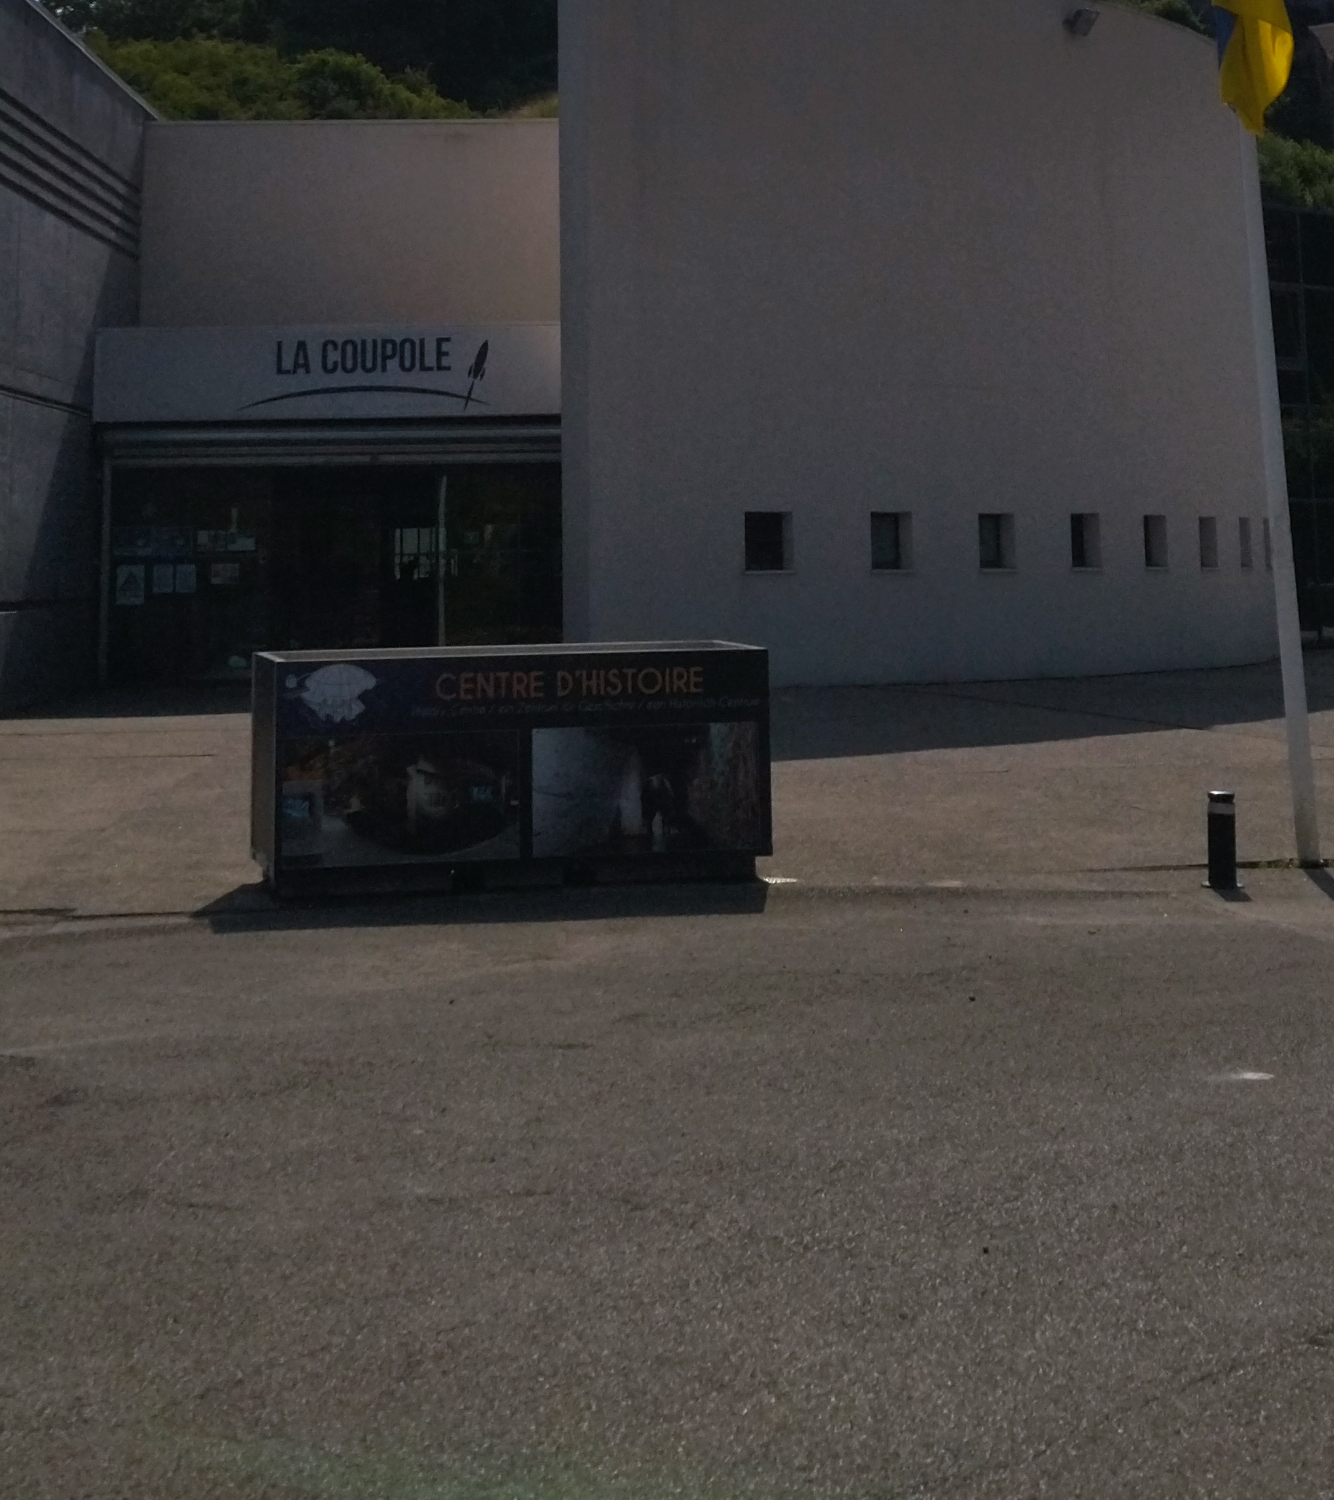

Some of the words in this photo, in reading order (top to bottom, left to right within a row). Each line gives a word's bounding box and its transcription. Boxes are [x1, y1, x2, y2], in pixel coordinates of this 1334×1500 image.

[276, 339, 311, 375] LA
[321, 337, 452, 374] COUPOLE
[435, 670, 544, 701] CENTRE
[556, 666, 705, 697] D'HISTOIRE
